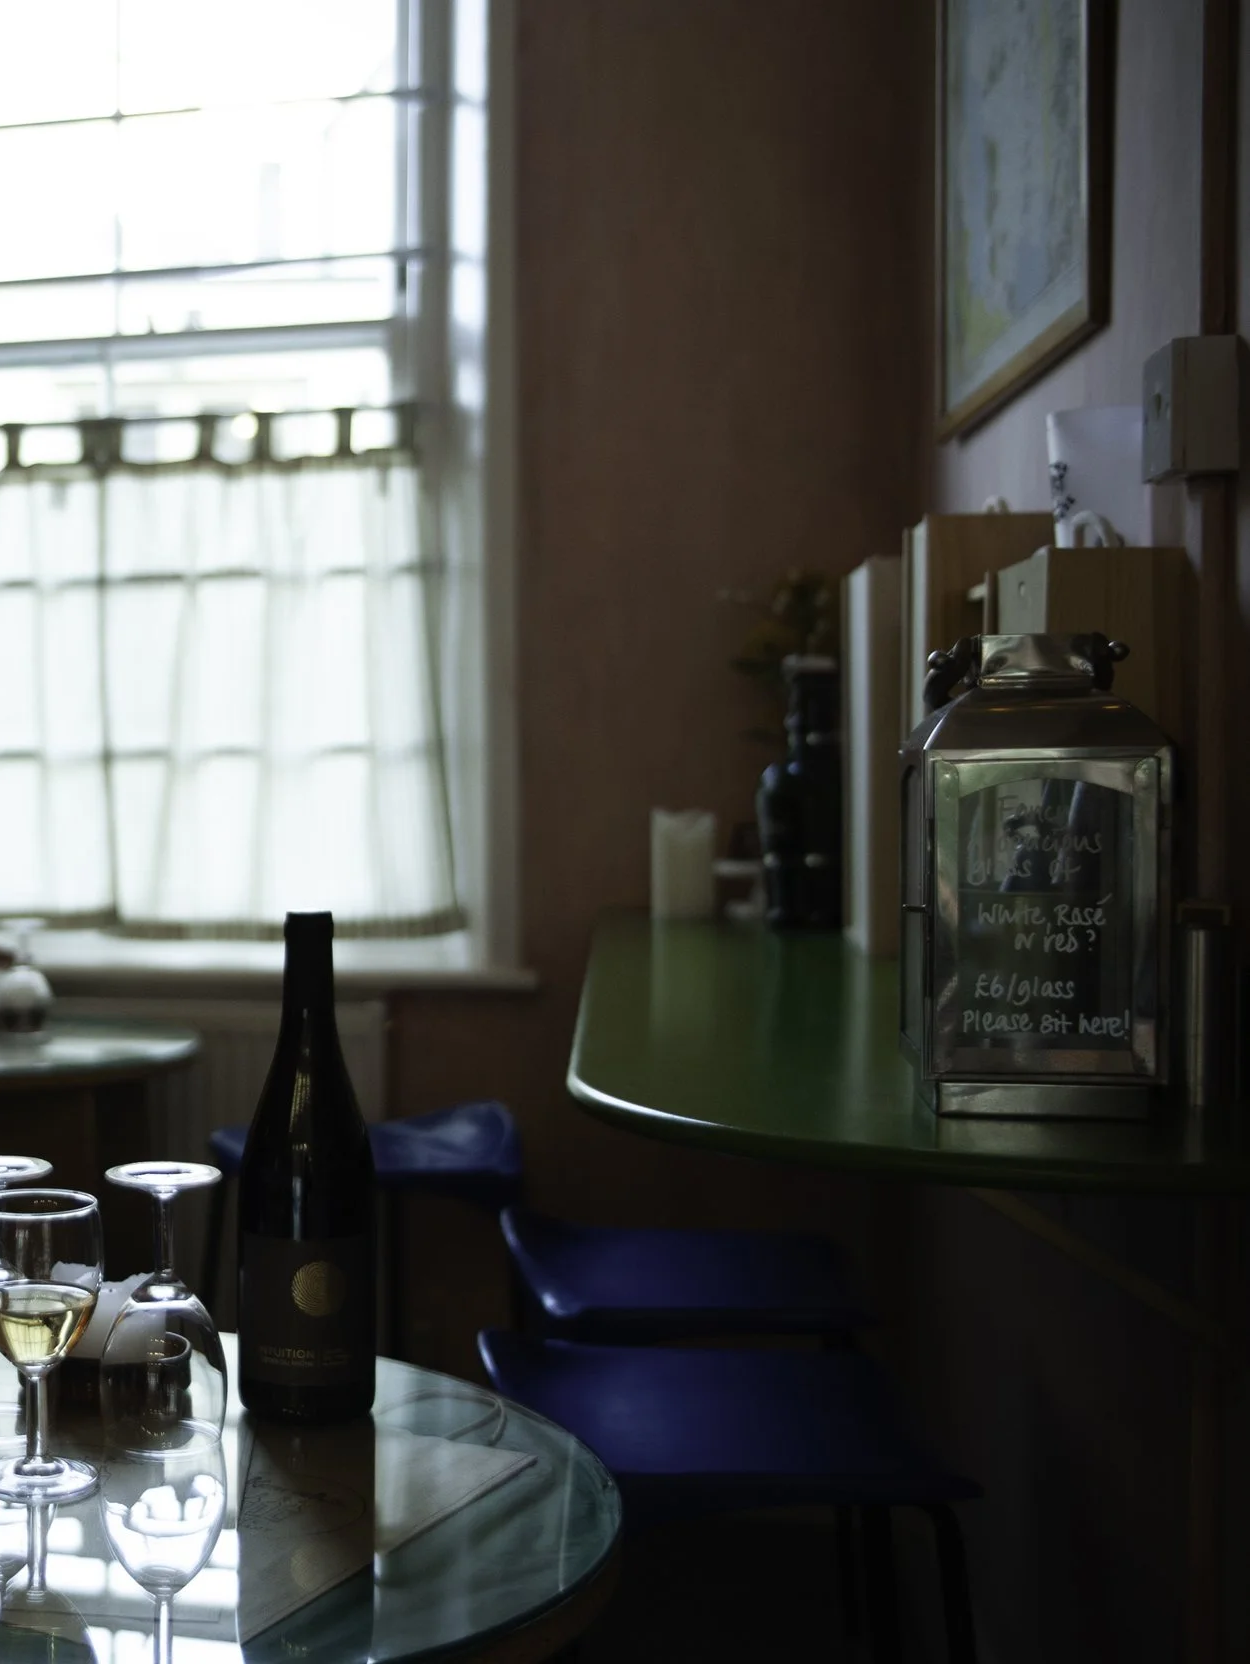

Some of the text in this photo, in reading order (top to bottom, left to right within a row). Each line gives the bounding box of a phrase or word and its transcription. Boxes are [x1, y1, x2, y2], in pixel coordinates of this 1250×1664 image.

[967, 856, 1082, 886] glss of
[1053, 893, 1113, 926] Rosé
[1014, 932, 1036, 950] or
[974, 973, 1075, 1006] £6/glass
[963, 1009, 1033, 1034] Please
[1078, 1009, 1130, 1040] here!
[257, 1345, 316, 1359] NTUITION
